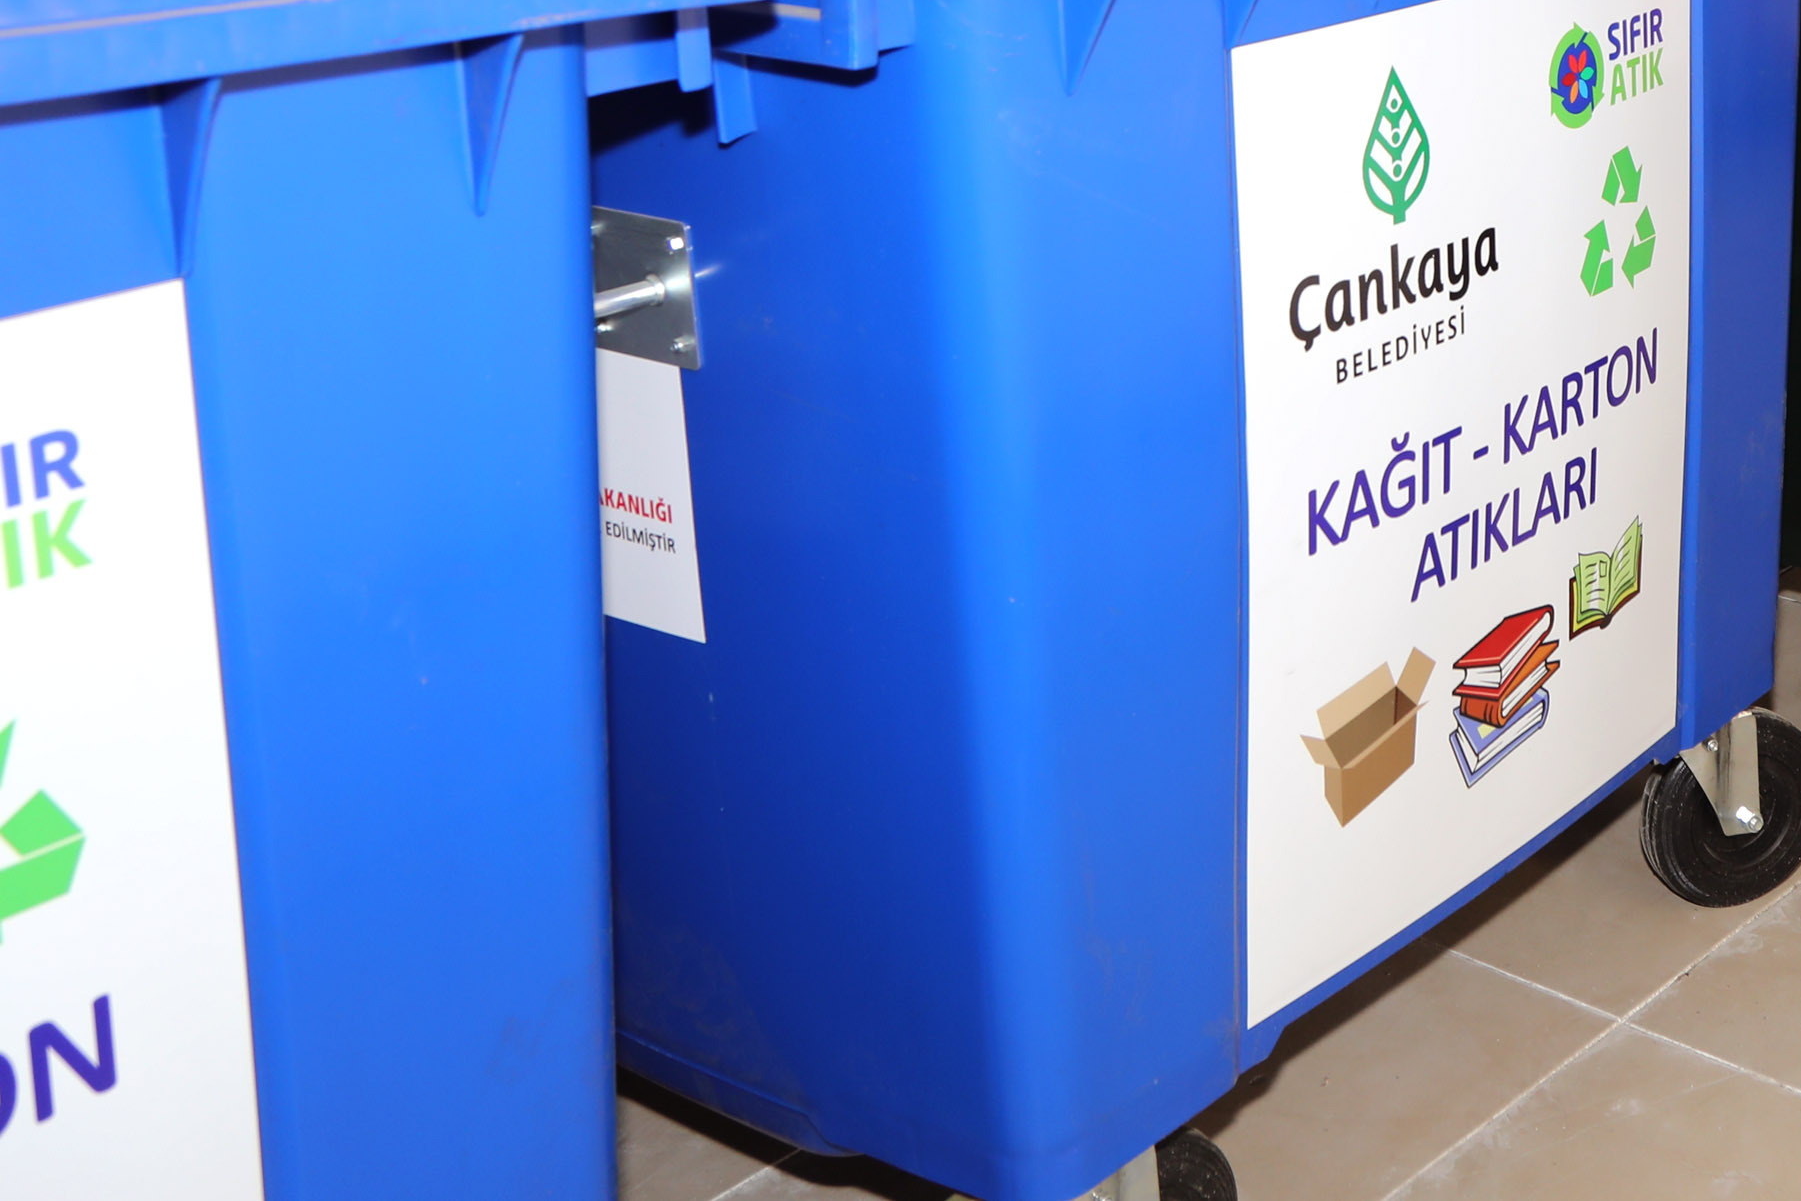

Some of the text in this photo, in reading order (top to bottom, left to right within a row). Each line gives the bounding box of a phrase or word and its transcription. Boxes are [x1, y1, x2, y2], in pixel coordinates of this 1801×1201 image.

[1608, 8, 1663, 61] SIFIR
[1610, 47, 1664, 106] ATIK
[1289, 227, 1499, 352] Çankaya
[1335, 305, 1465, 384] BELEDİYESİ
[0, 428, 86, 509] IR
[1308, 424, 1463, 556] KAĞIT
[1503, 327, 1659, 465] KARTON
[0, 497, 94, 589] IK
[1410, 447, 1598, 603] ATIKLARI
